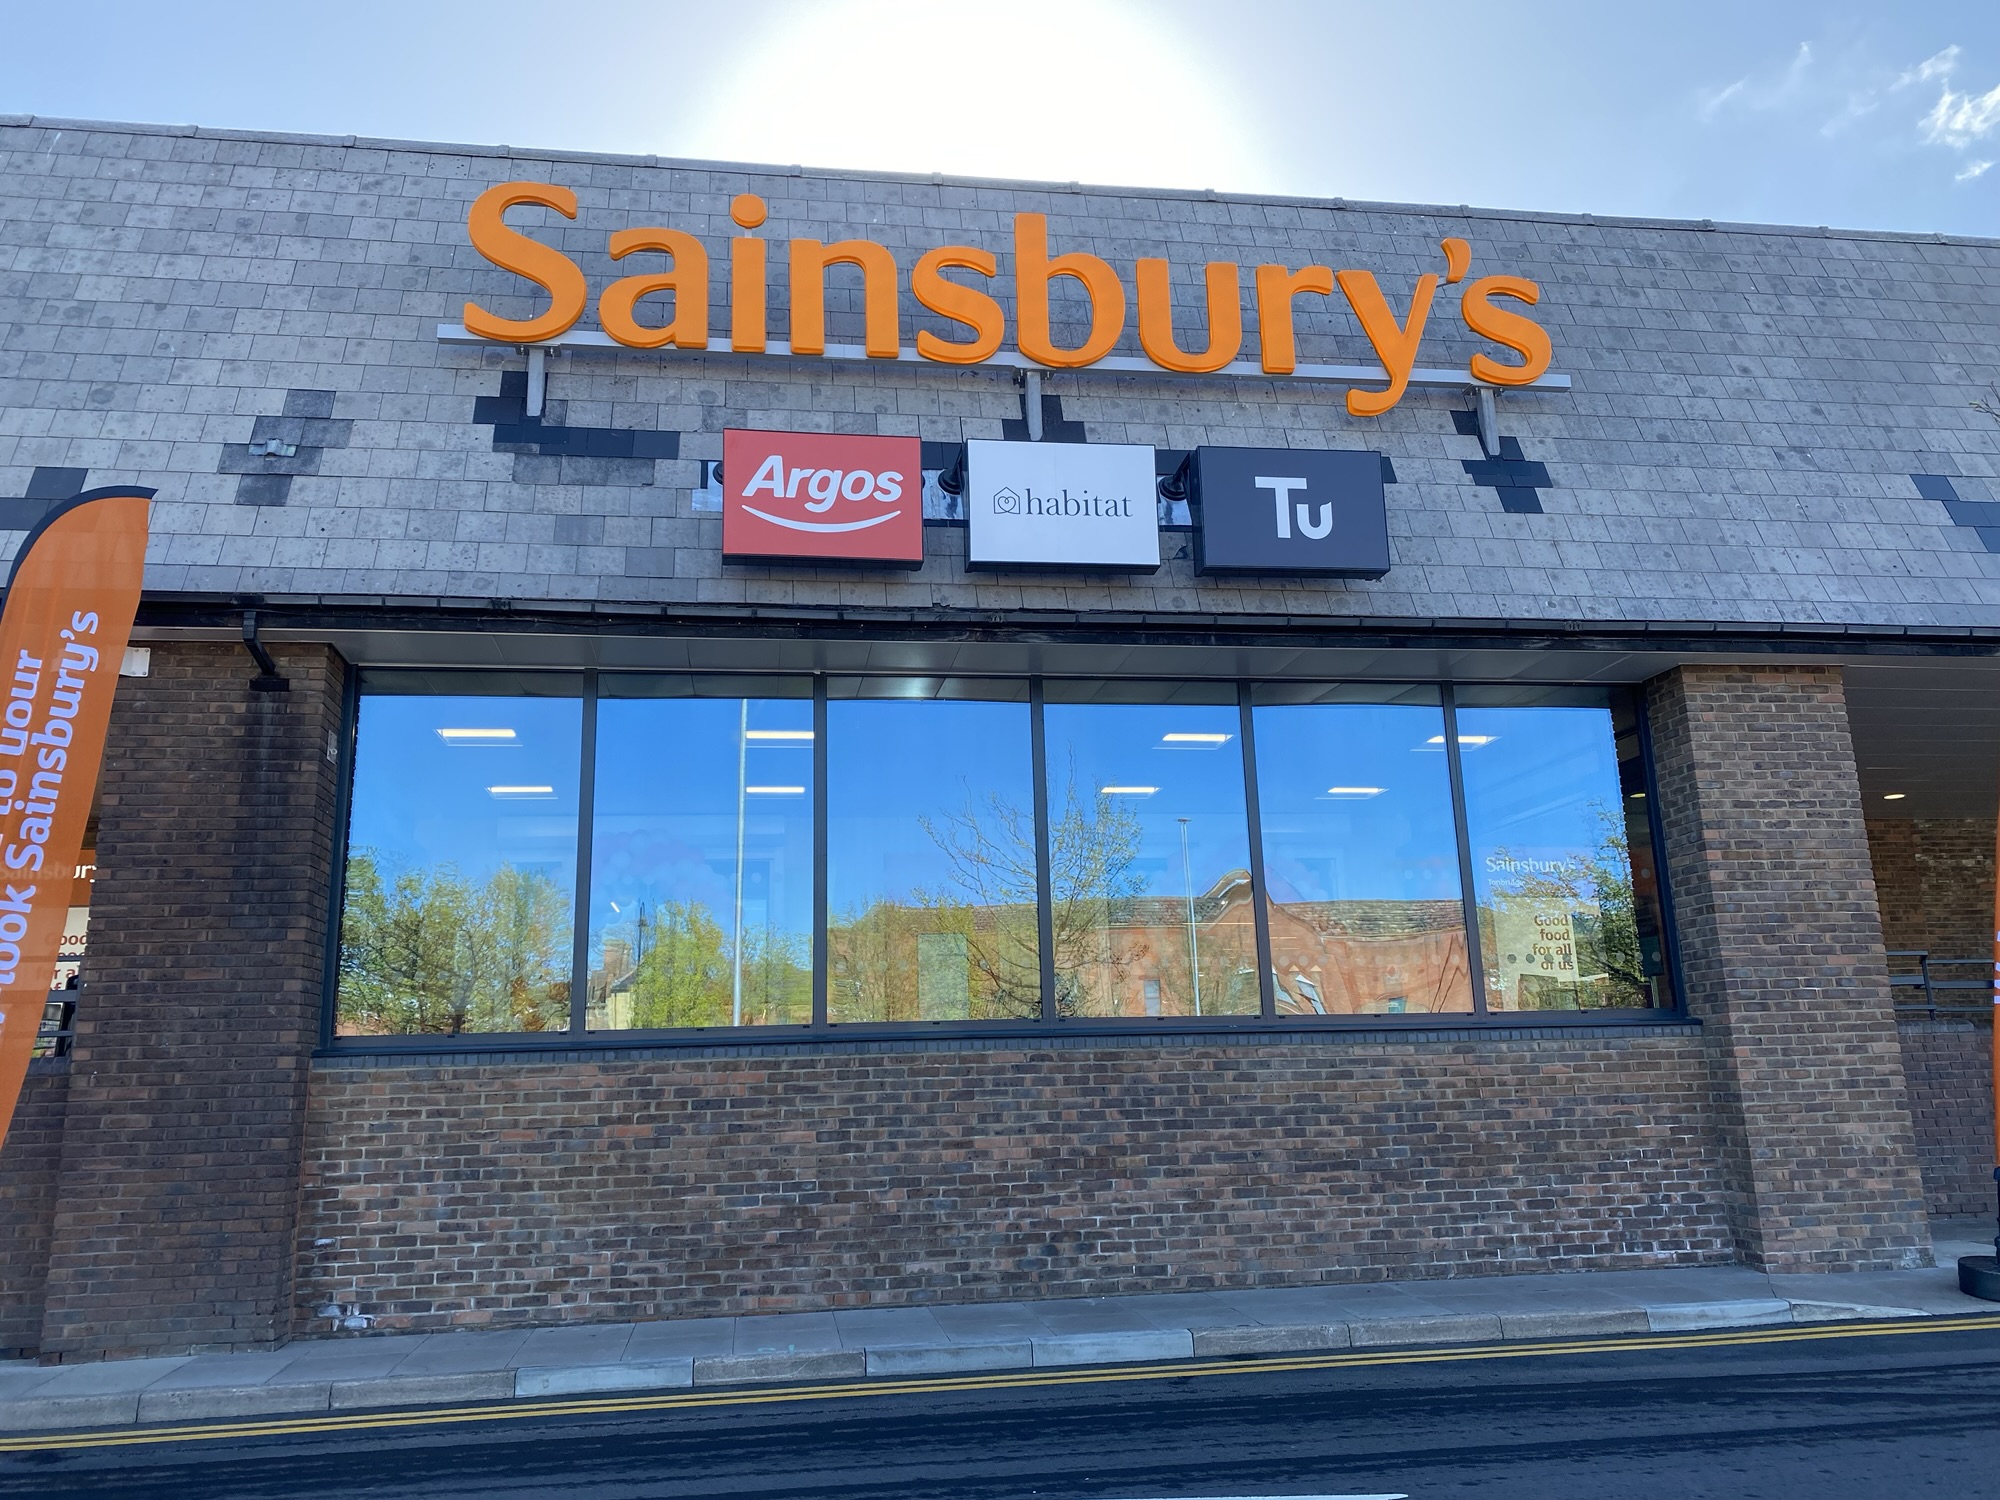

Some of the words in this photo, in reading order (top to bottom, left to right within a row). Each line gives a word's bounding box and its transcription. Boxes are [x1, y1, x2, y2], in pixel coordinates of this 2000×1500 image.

[464, 181, 1553, 416] Sainsbury's
[741, 455, 904, 513] Argos
[1026, 488, 1133, 517] habitat
[1254, 476, 1333, 540] Tu
[0, 649, 43, 756] your
[5, 610, 99, 872] Sainsbury's
[1486, 857, 1577, 874] Sainsbury's
[1534, 914, 1569, 926] Good
[1540, 928, 1570, 941] food
[1532, 943, 1551, 956] for
[1556, 943, 1572, 956] all
[1558, 961, 1574, 970] us
